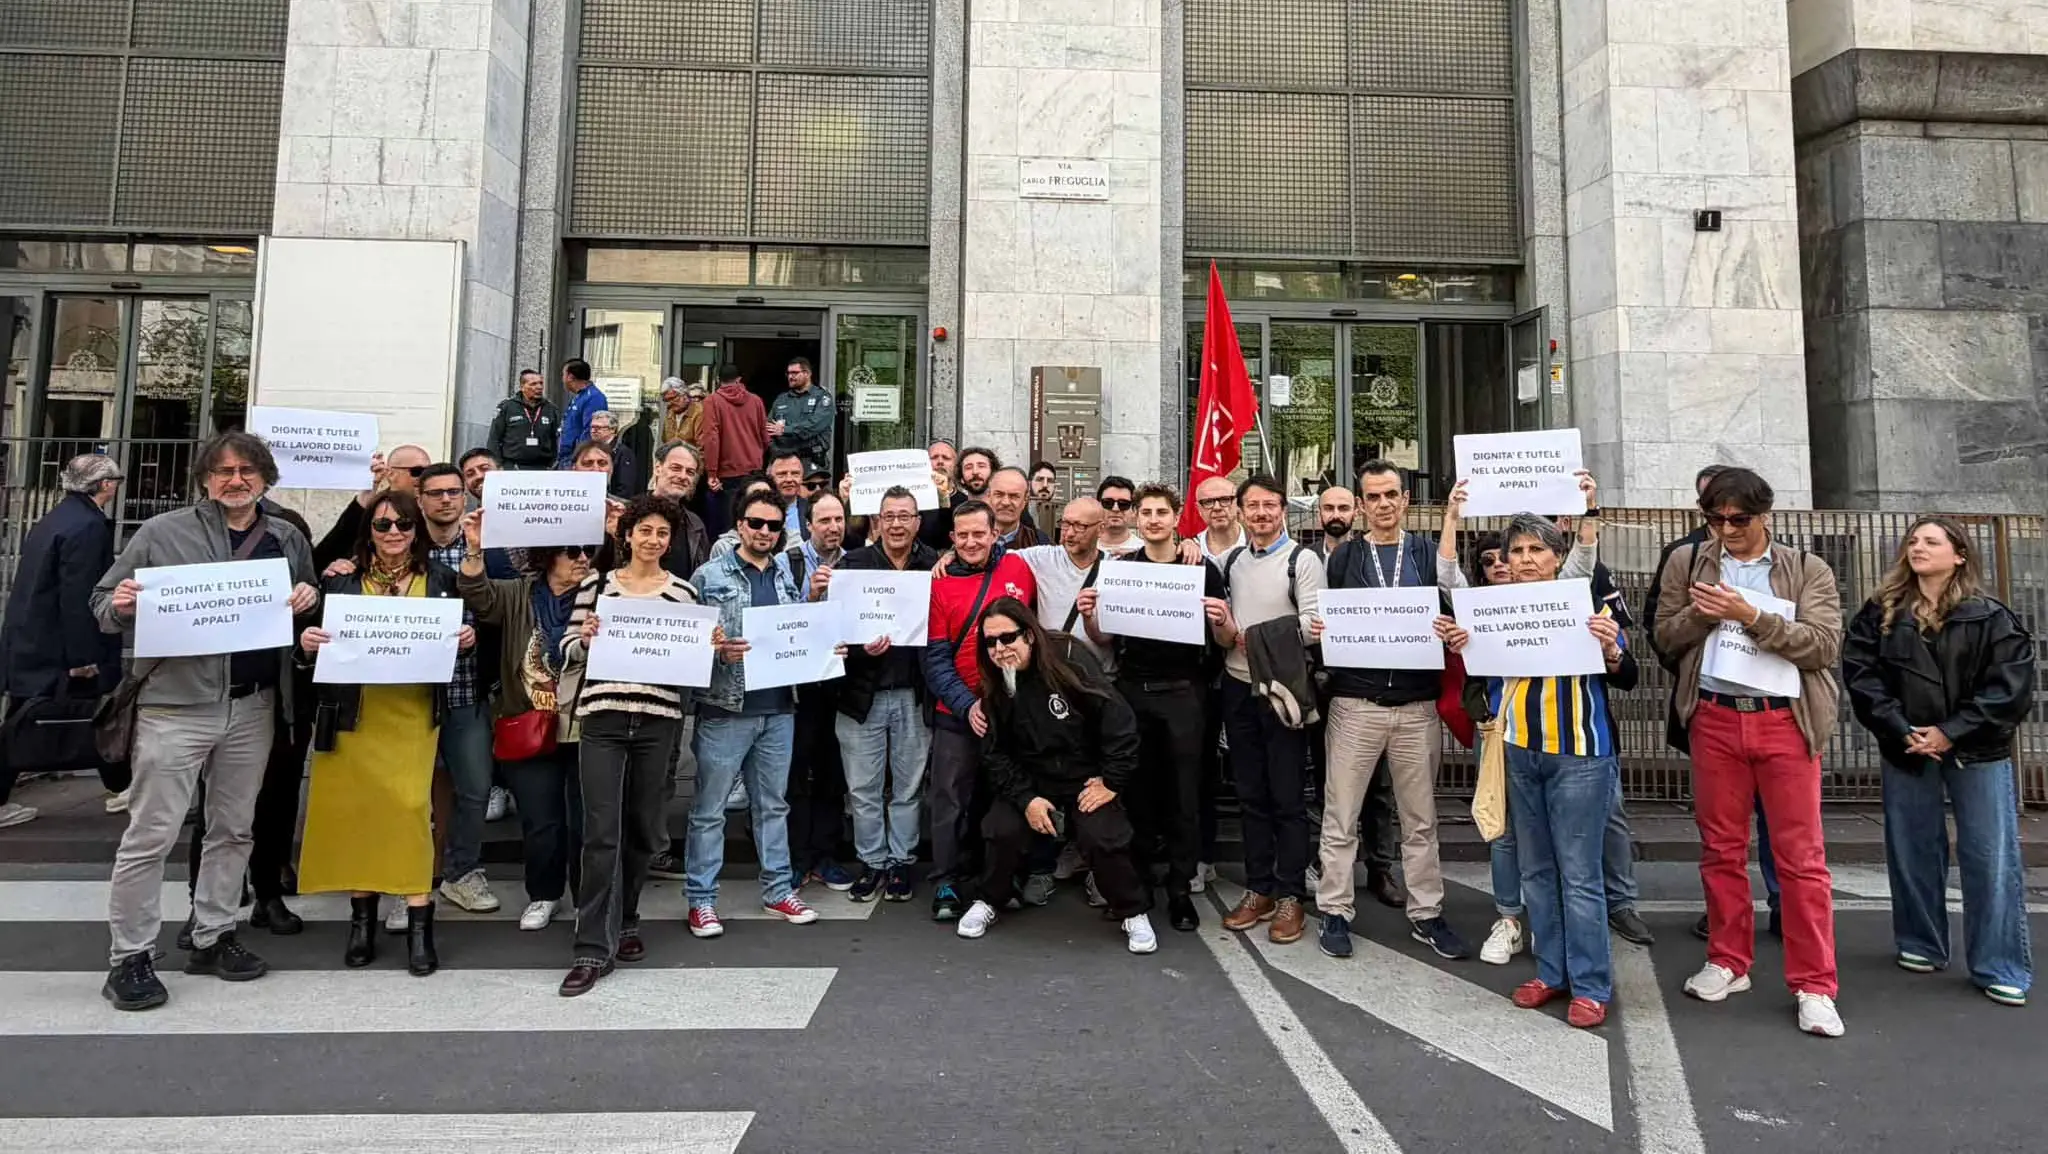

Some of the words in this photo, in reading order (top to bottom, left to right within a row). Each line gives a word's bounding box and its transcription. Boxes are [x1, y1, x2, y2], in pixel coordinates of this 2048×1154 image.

[1048, 176, 1106, 186] FREGUGLIA
[272, 426, 316, 435] DIGNITA'
[326, 428, 360, 437] TUTELE
[268, 441, 288, 449] NEL
[290, 441, 331, 450] LAVORO
[333, 442, 362, 451] DEGLI
[293, 455, 334, 464] APPALTI
[1473, 452, 1516, 460] DIGNITA'
[1525, 450, 1561, 459] TUTELE
[1472, 467, 1489, 475] NEL
[1492, 466, 1532, 474] LAVORO
[1499, 480, 1538, 488] APPALTI
[500, 488, 544, 497] DIGNITA'
[545, 489, 550, 497] E
[554, 489, 588, 498] TUTELE
[498, 503, 517, 511] NEL
[519, 503, 559, 511] LAVORO
[560, 503, 589, 512] DEGLI
[160, 582, 215, 596] DIGNITA'
[217, 582, 224, 591] E
[227, 579, 269, 590] TUTELE
[1104, 578, 1143, 587] DECRETO
[1155, 581, 1196, 591] MAGGIO?
[863, 586, 895, 595] LAVORO
[158, 603, 182, 613] NEL
[186, 598, 235, 611] LAVORO
[238, 595, 272, 606] DEGLI
[1105, 604, 1145, 614] TUTELARE
[1157, 609, 1194, 619] LAVORO!
[1326, 606, 1371, 615] DECRETO
[1384, 606, 1430, 614] MAGGIO?
[1473, 606, 1519, 617] DIGNITA'
[1521, 605, 1527, 613] E
[1529, 602, 1570, 612] TUTELE
[192, 613, 240, 627] APPALTI
[344, 614, 393, 623] DIGNITA'
[404, 615, 441, 624] TUTELE
[612, 615, 655, 625] DIGNITA'
[665, 618, 698, 628] TUTELE
[859, 612, 896, 621] DIGNITA'
[777, 620, 809, 631] LAVORO
[1474, 624, 1494, 633] NEL
[1496, 620, 1540, 632] LAVORO
[1542, 619, 1576, 628] DEGLI
[340, 630, 360, 639] NEL
[364, 630, 408, 640] LAVORO
[410, 631, 442, 640] DEGLI
[608, 629, 626, 638] NEL
[628, 631, 668, 642] LAVORO
[670, 634, 699, 643] DEGLI
[789, 636, 794, 644] E
[1330, 635, 1376, 643] TUTELARE
[1379, 635, 1386, 643] IL
[1388, 635, 1431, 643] LAVORO!
[1506, 637, 1548, 648] APPALTI
[368, 646, 411, 655] APPALTI
[632, 646, 670, 656] APPALTI
[1720, 640, 1758, 656] APPALTI
[775, 649, 809, 660] DIGNITA'
